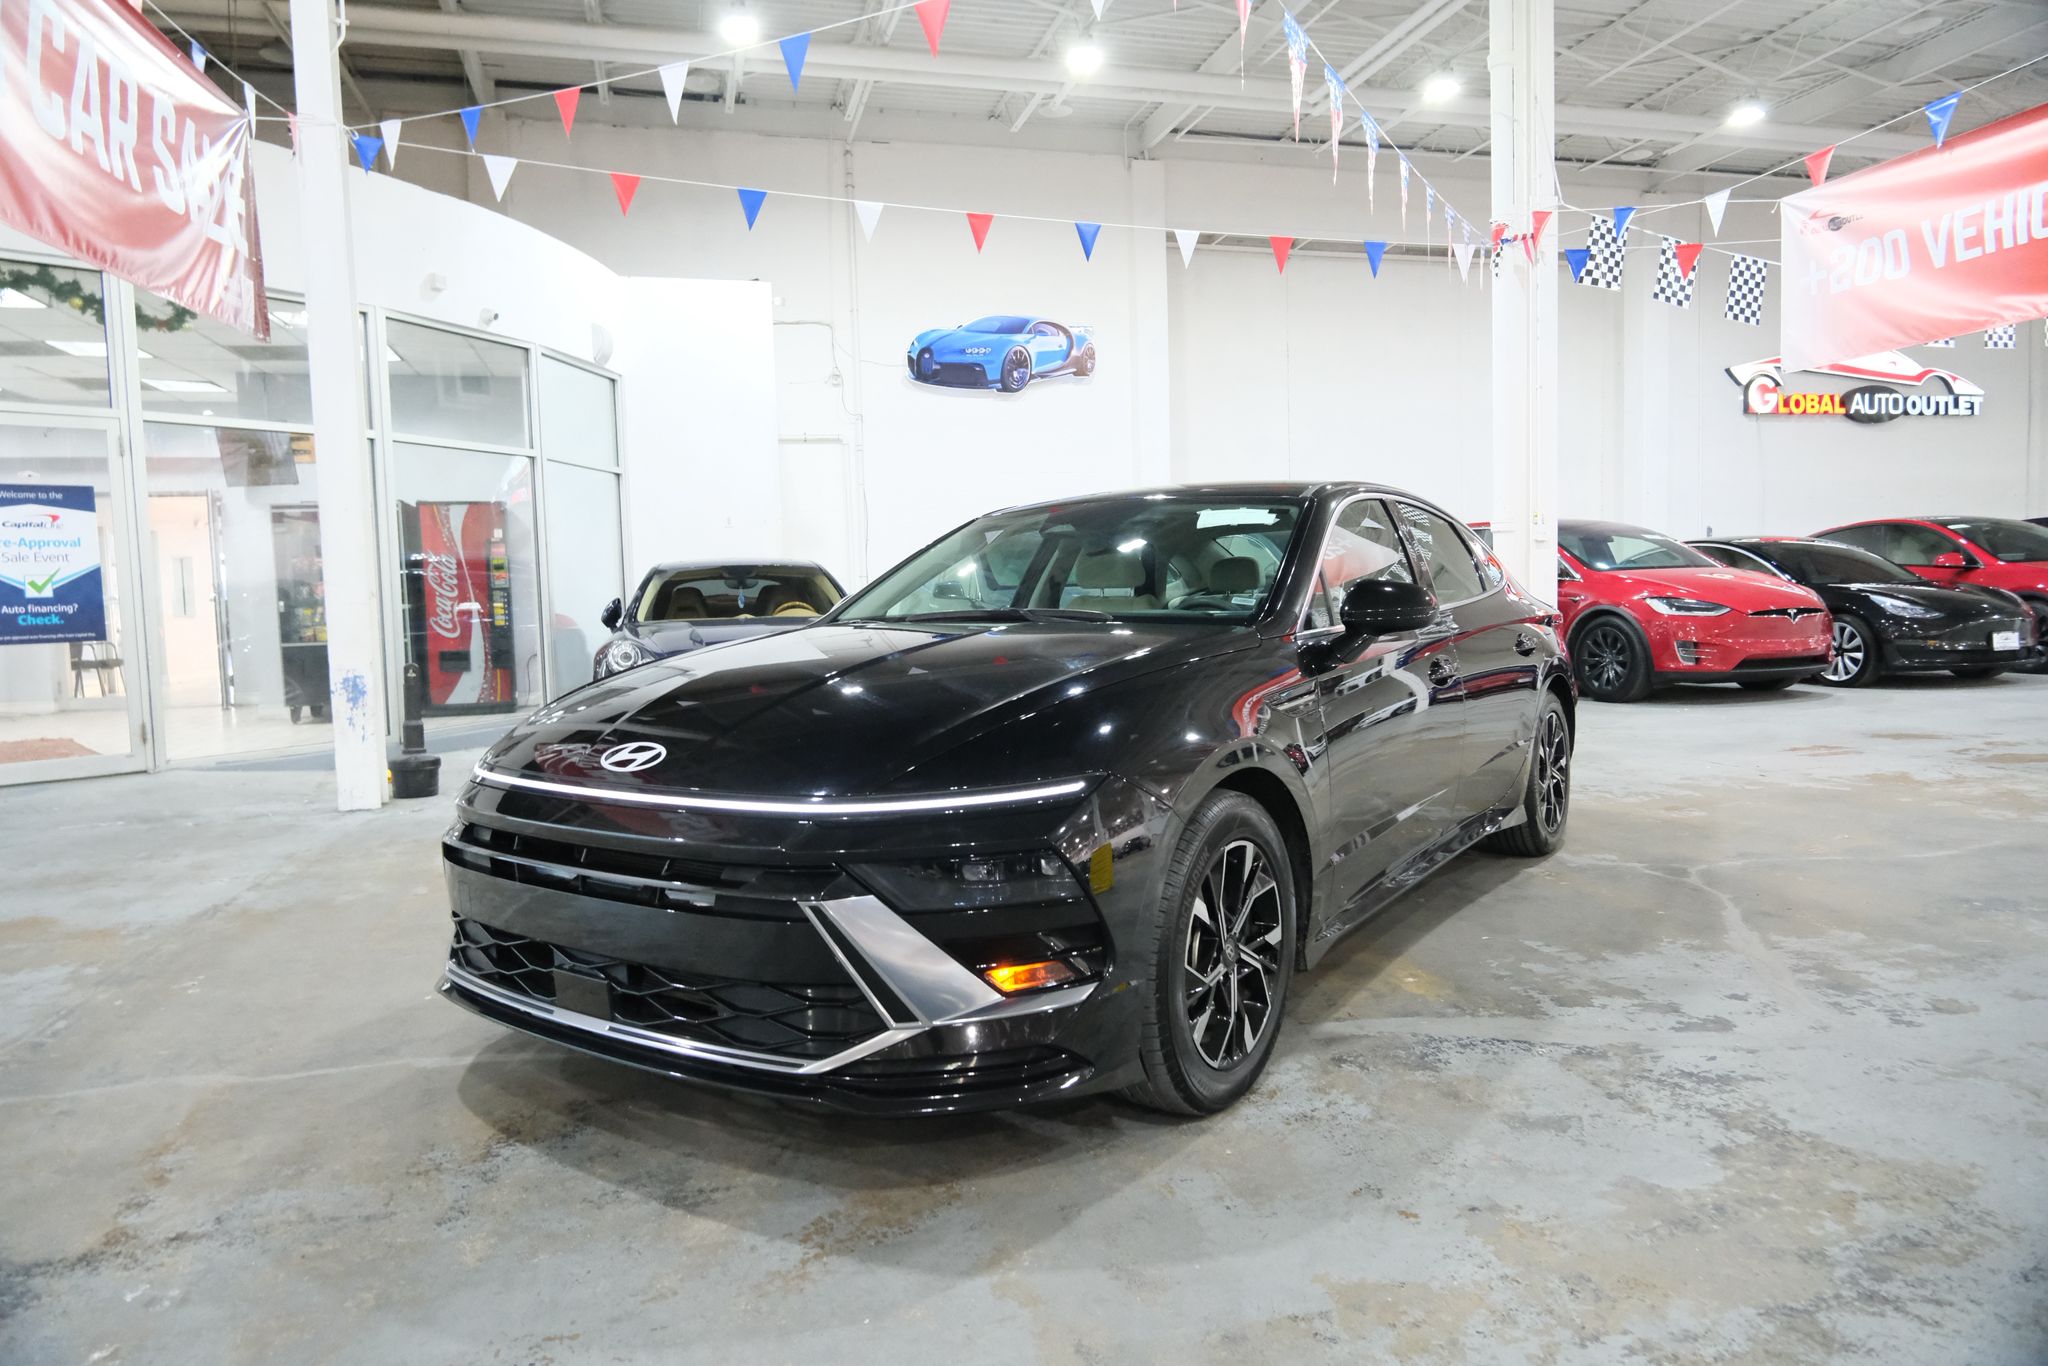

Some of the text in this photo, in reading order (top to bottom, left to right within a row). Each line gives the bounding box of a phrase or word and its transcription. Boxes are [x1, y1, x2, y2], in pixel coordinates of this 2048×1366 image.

[26, 0, 142, 193] CAR
[1802, 229, 1910, 295] +200
[1749, 376, 1984, 416] GLOBAL AUTO OUTLET
[38, 491, 47, 499] to
[49, 491, 63, 499] the
[2, 521, 43, 529] Capital
[1, 552, 70, 562] Sale Event
[1, 603, 79, 614] Auto financing?
[17, 614, 65, 625] Check.
